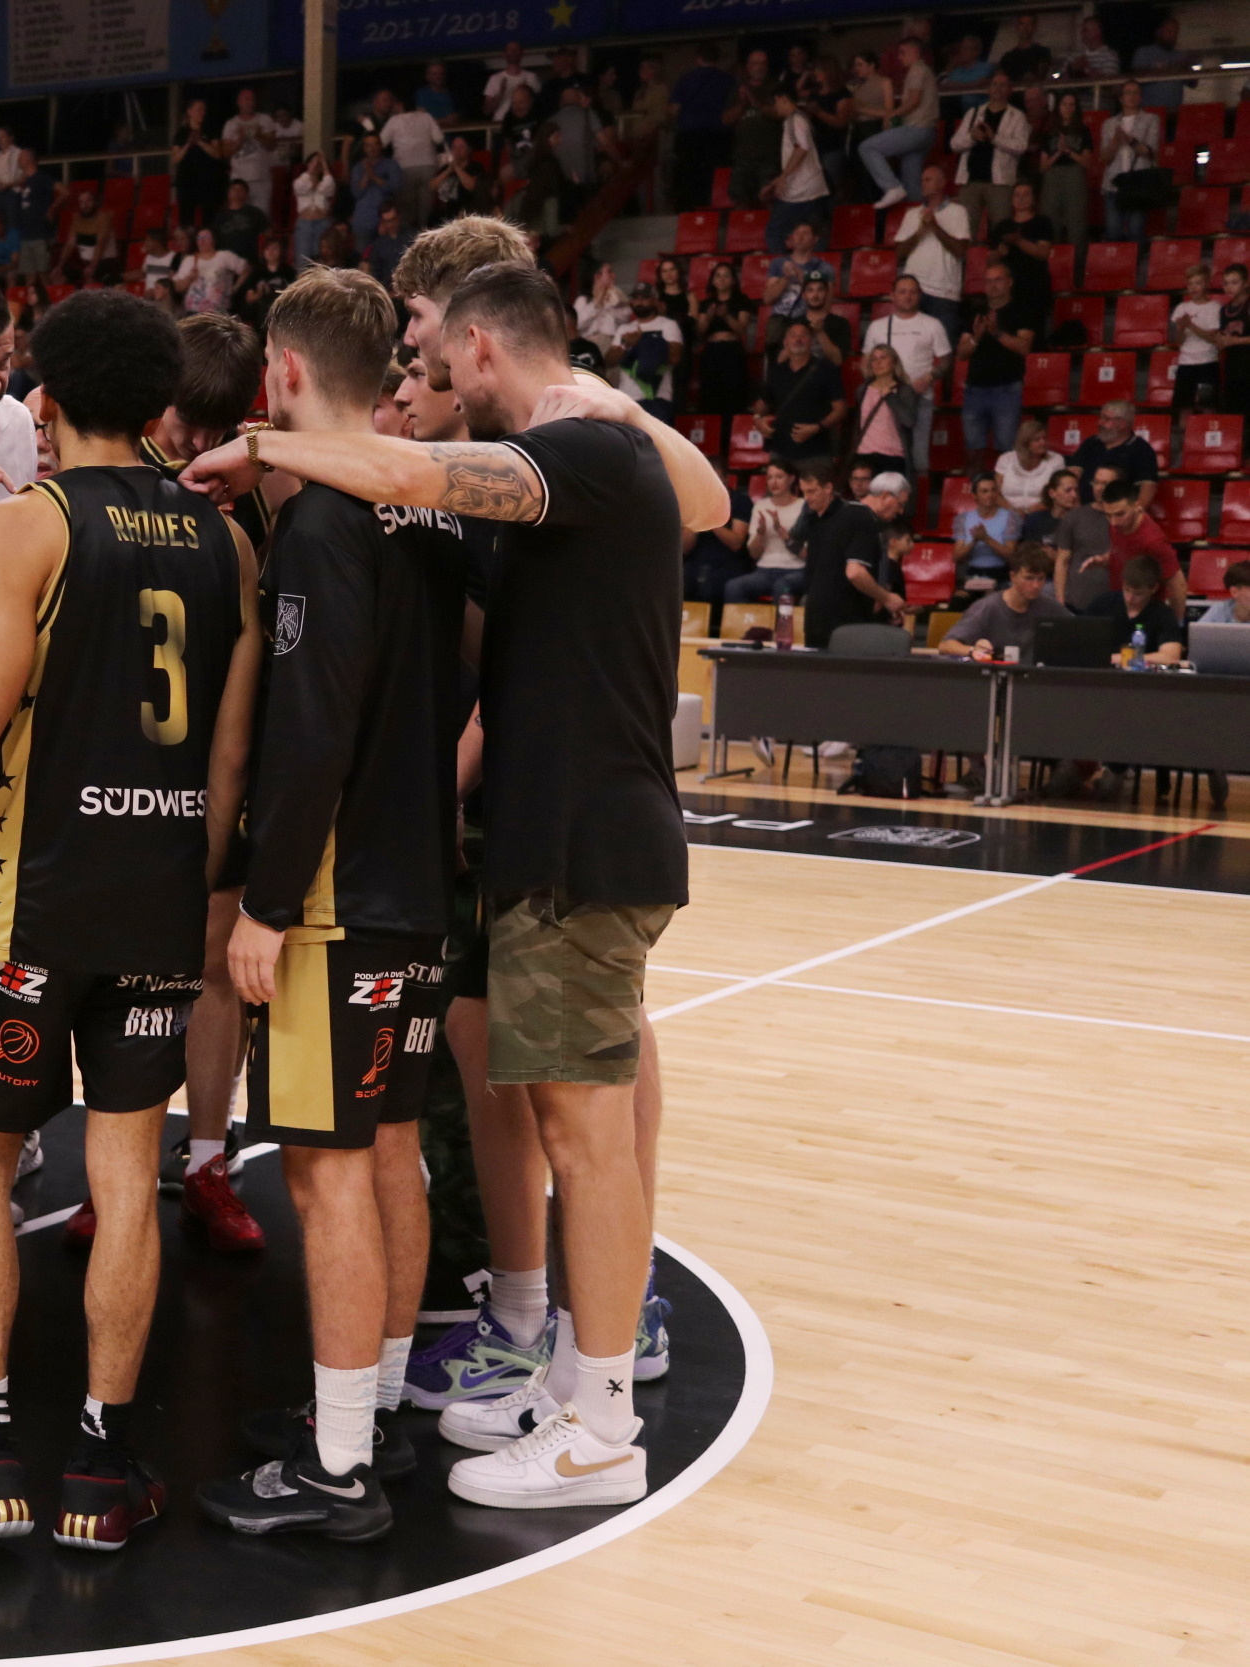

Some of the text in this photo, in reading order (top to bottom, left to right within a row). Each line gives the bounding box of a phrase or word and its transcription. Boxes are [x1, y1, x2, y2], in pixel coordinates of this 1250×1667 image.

[363, 10, 519, 43] 2017/2018
[106, 505, 199, 550] RHODES
[139, 588, 188, 746] 3
[24, 964, 49, 976] DVERE
[0, 985, 40, 1004] založené 1998
[125, 1006, 173, 1037] BENY
